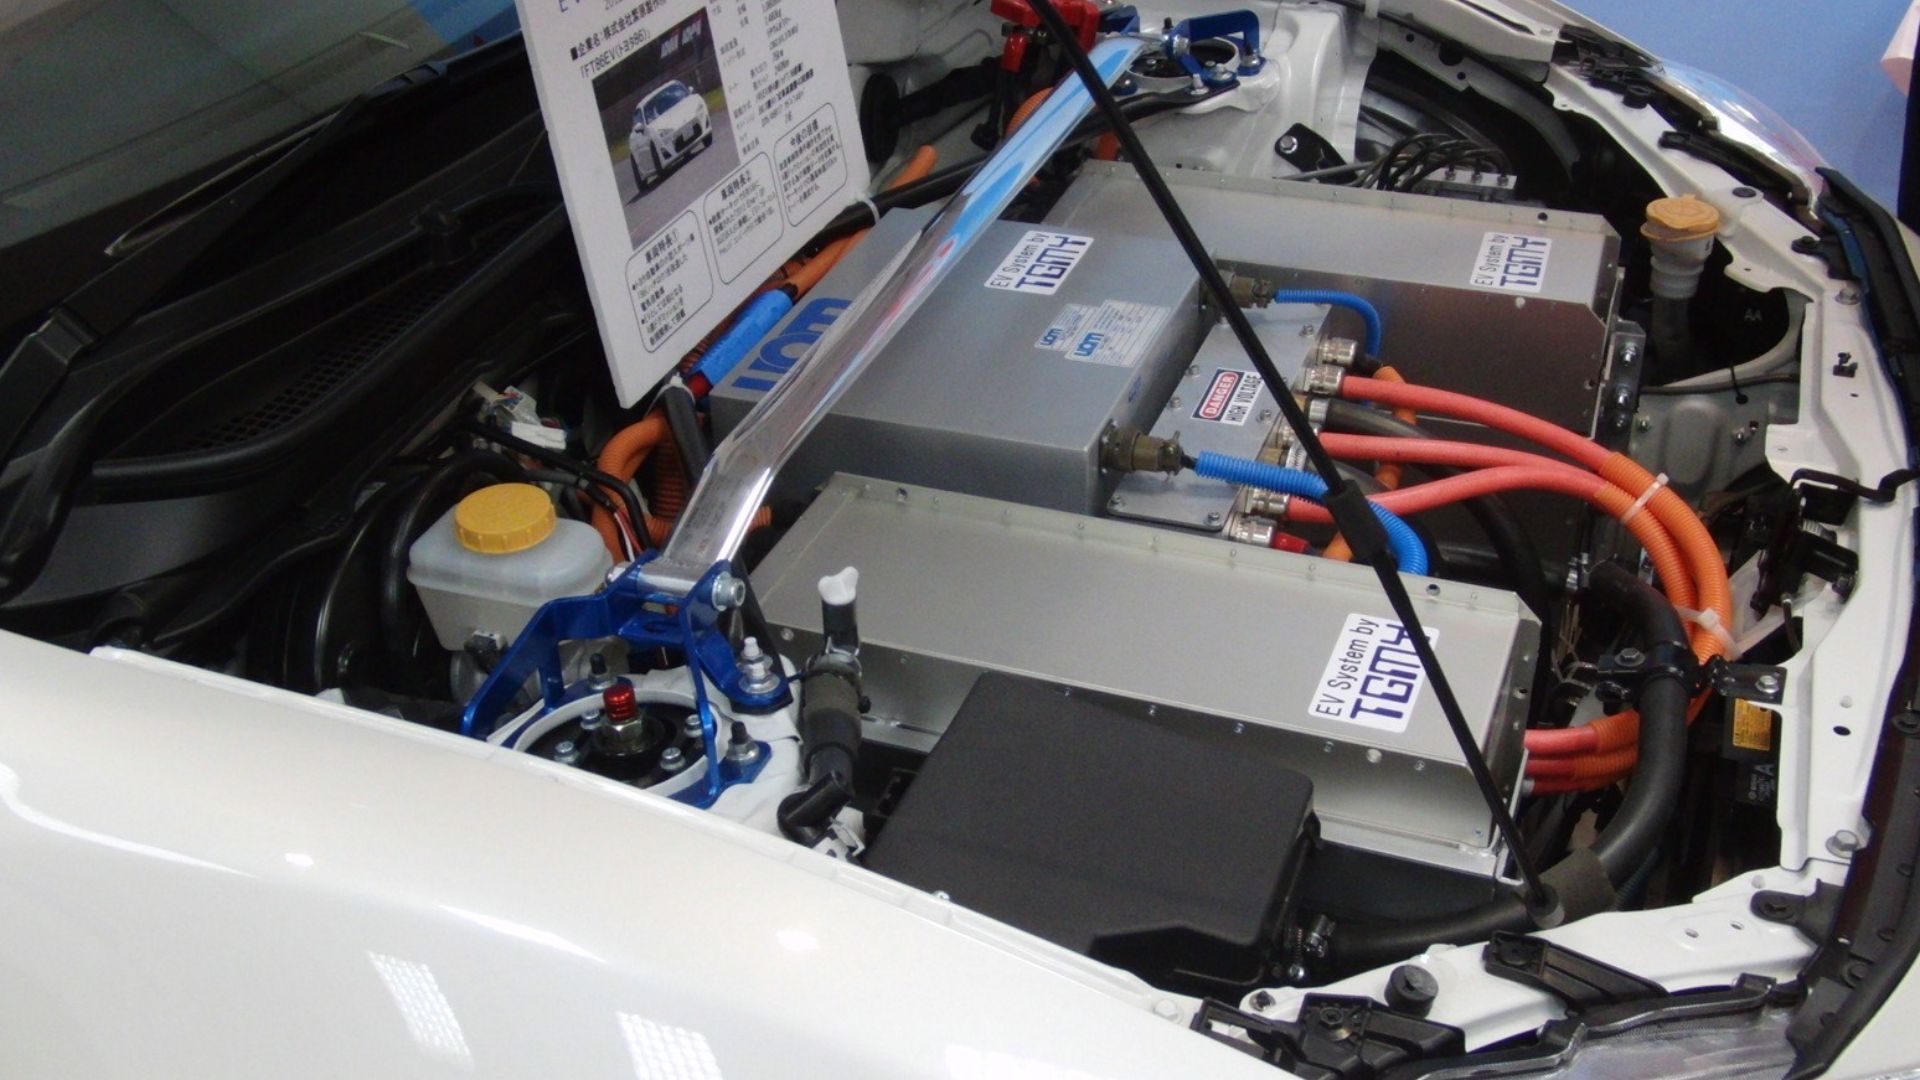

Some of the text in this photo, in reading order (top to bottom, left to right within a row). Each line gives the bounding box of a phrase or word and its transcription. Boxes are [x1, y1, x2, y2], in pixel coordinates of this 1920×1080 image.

[990, 232, 1049, 288] EV System by
[1475, 234, 1508, 286] EV System by
[1204, 375, 1235, 415] DANGER
[1225, 375, 1262, 422] HIGH VOLTAGE
[1316, 618, 1379, 716] EV System by
